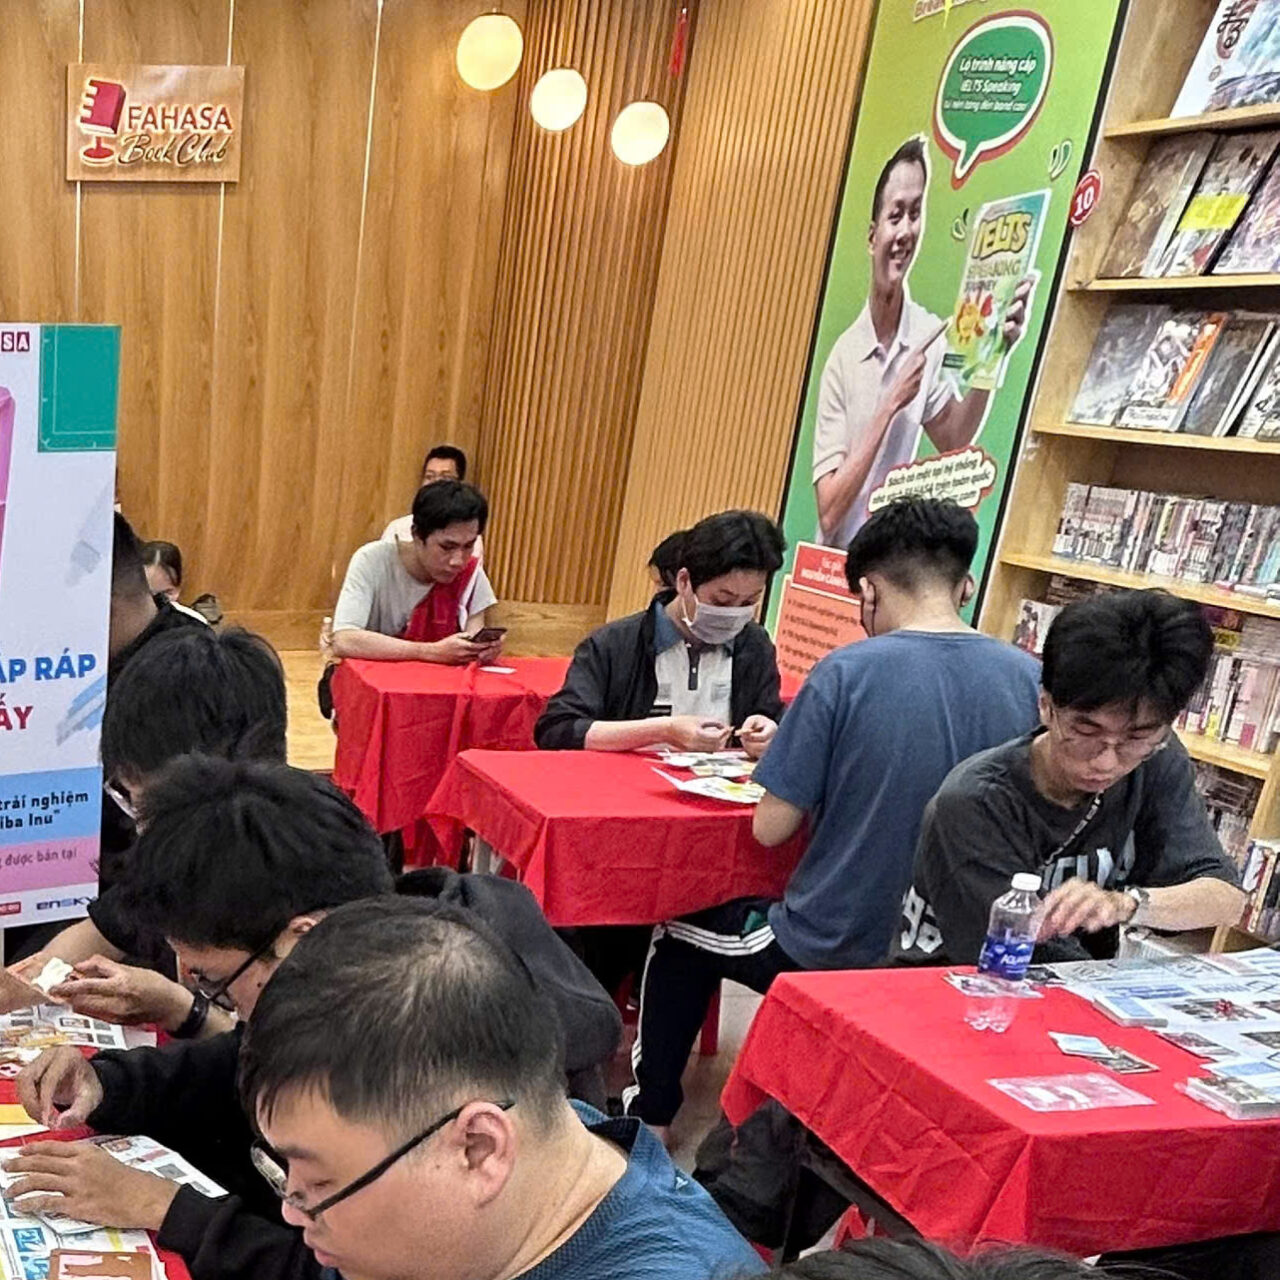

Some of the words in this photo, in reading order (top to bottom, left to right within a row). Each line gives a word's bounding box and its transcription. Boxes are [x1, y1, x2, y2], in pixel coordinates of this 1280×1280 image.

[128, 105, 234, 131] FAHASA
[118, 133, 174, 165] Book
[1074, 186, 1095, 217] 10
[972, 212, 1034, 261] IELTS
[34, 648, 97, 682] RÁP
[31, 790, 90, 813] nghiệm
[4, 852, 34, 867] được
[36, 848, 59, 863] bán
[61, 848, 78, 862] tại
